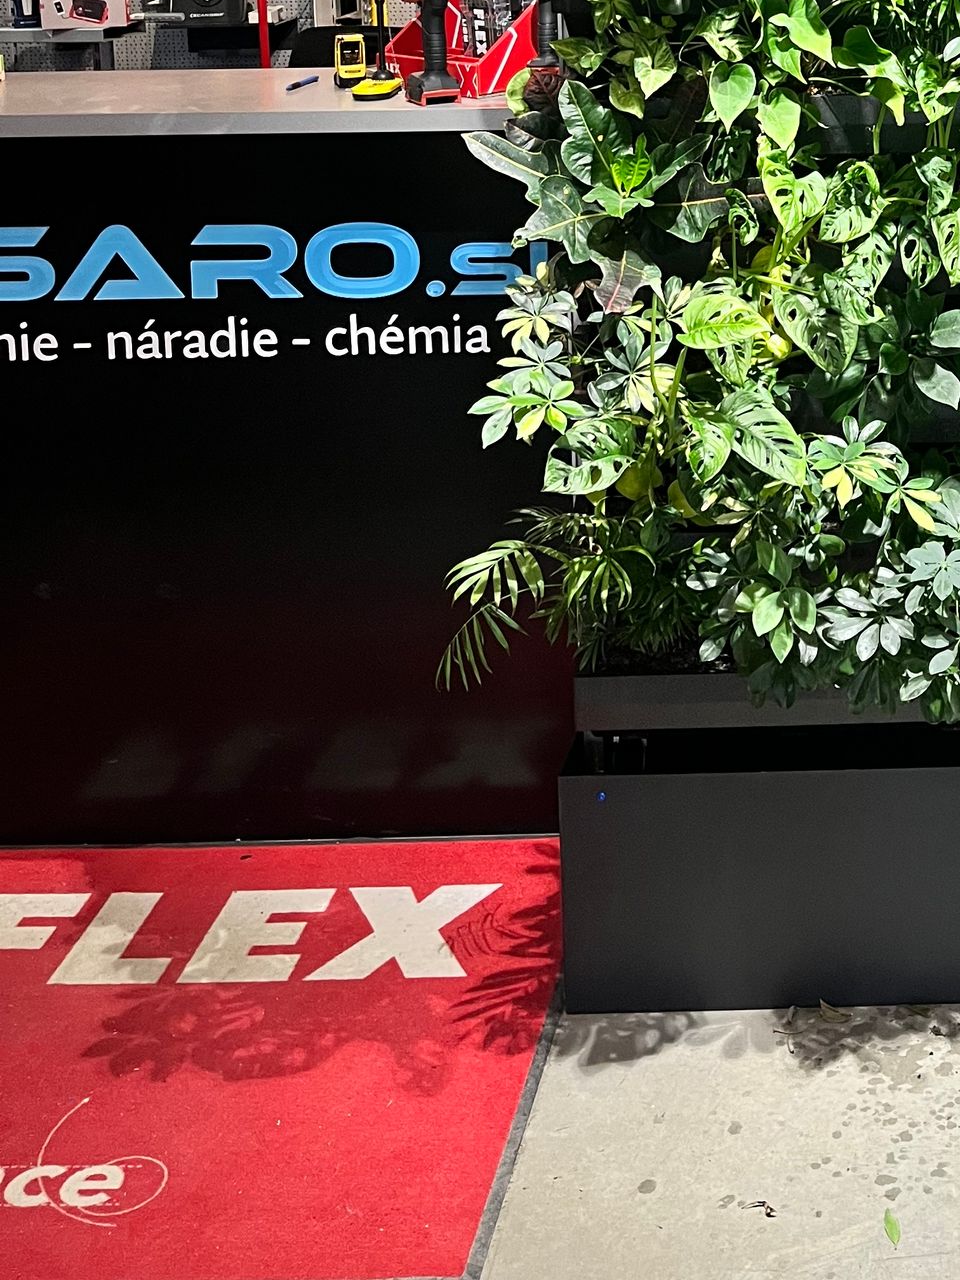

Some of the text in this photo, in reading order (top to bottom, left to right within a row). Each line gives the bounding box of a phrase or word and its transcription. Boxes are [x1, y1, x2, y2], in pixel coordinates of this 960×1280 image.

[107, 317, 279, 360] náradie
[325, 313, 491, 358] chémia
[0, 883, 503, 984] FLEX
